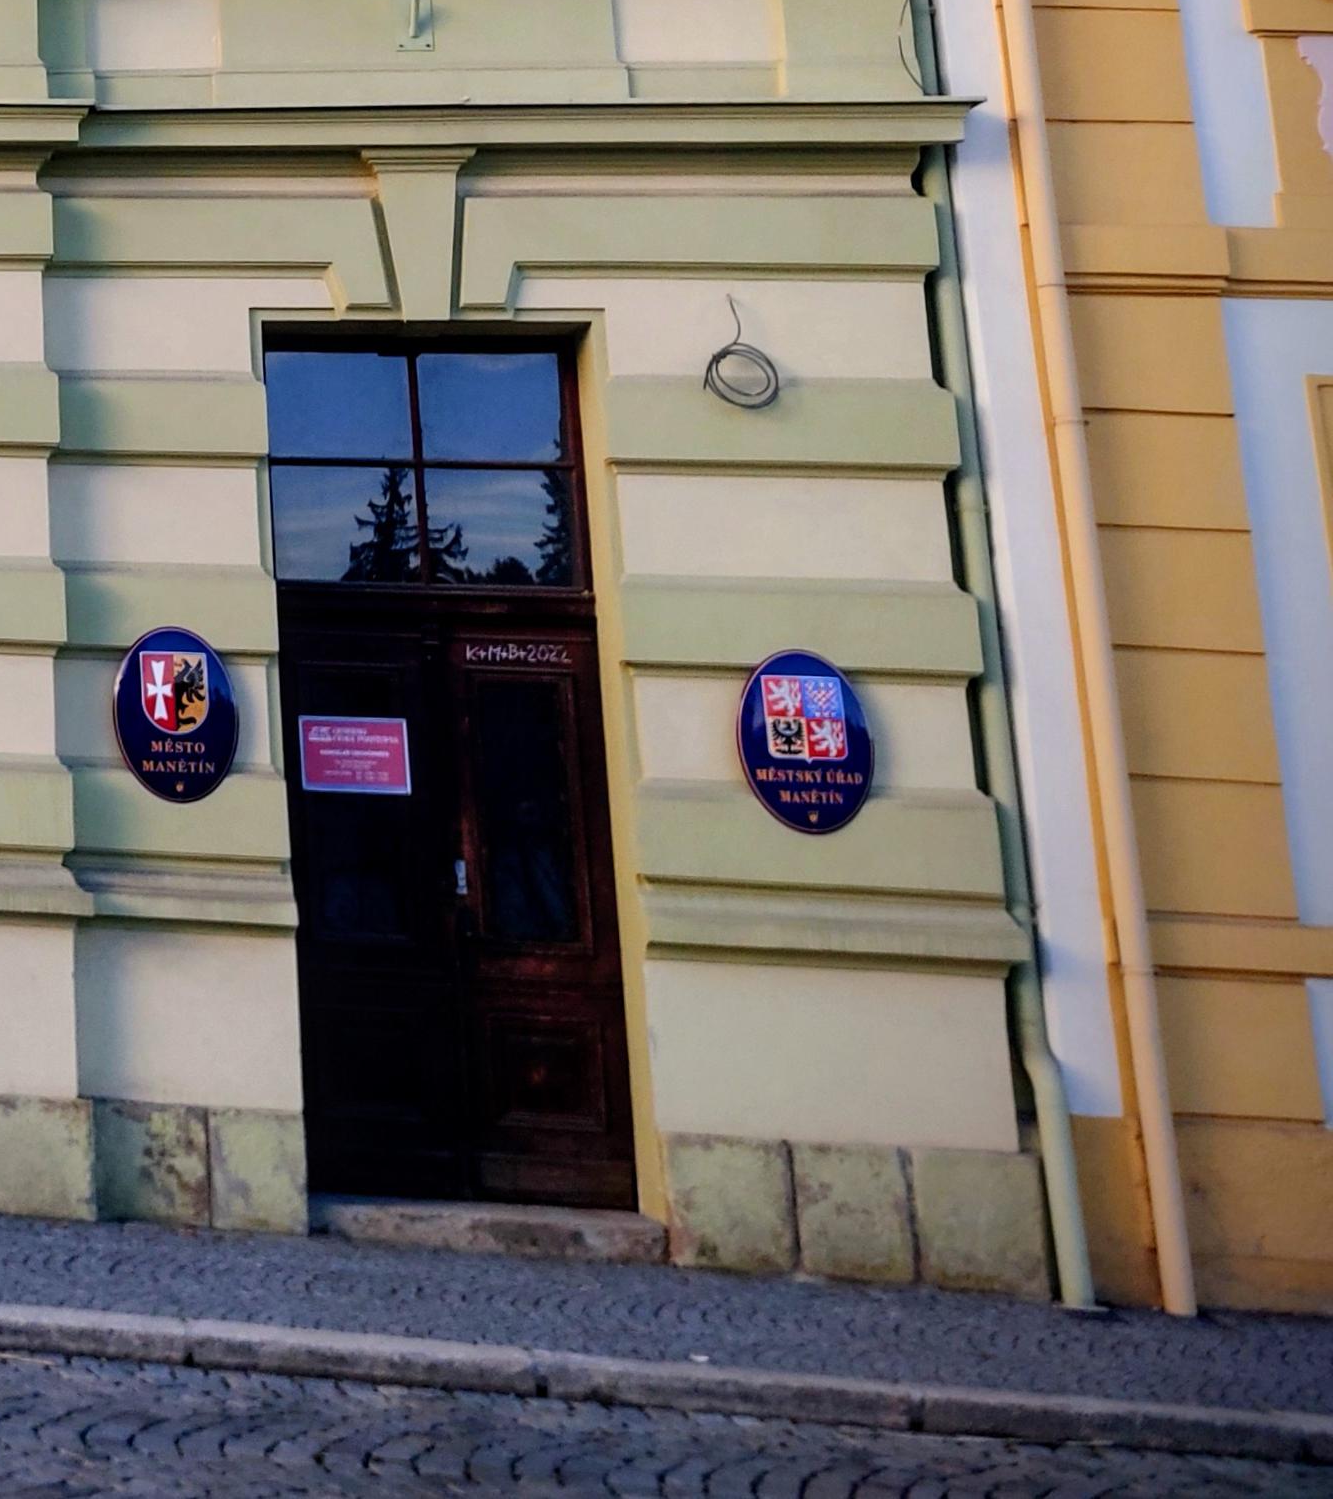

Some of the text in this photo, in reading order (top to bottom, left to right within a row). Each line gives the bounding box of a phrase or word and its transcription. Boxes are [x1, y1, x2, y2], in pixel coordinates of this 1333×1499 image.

[150, 737, 206, 754] MĚSTO
[141, 757, 216, 774] MANĚTÍN
[756, 765, 864, 785] MĚSTSKÝ ÚŘAD
[779, 788, 844, 805] MANĚTÍN
